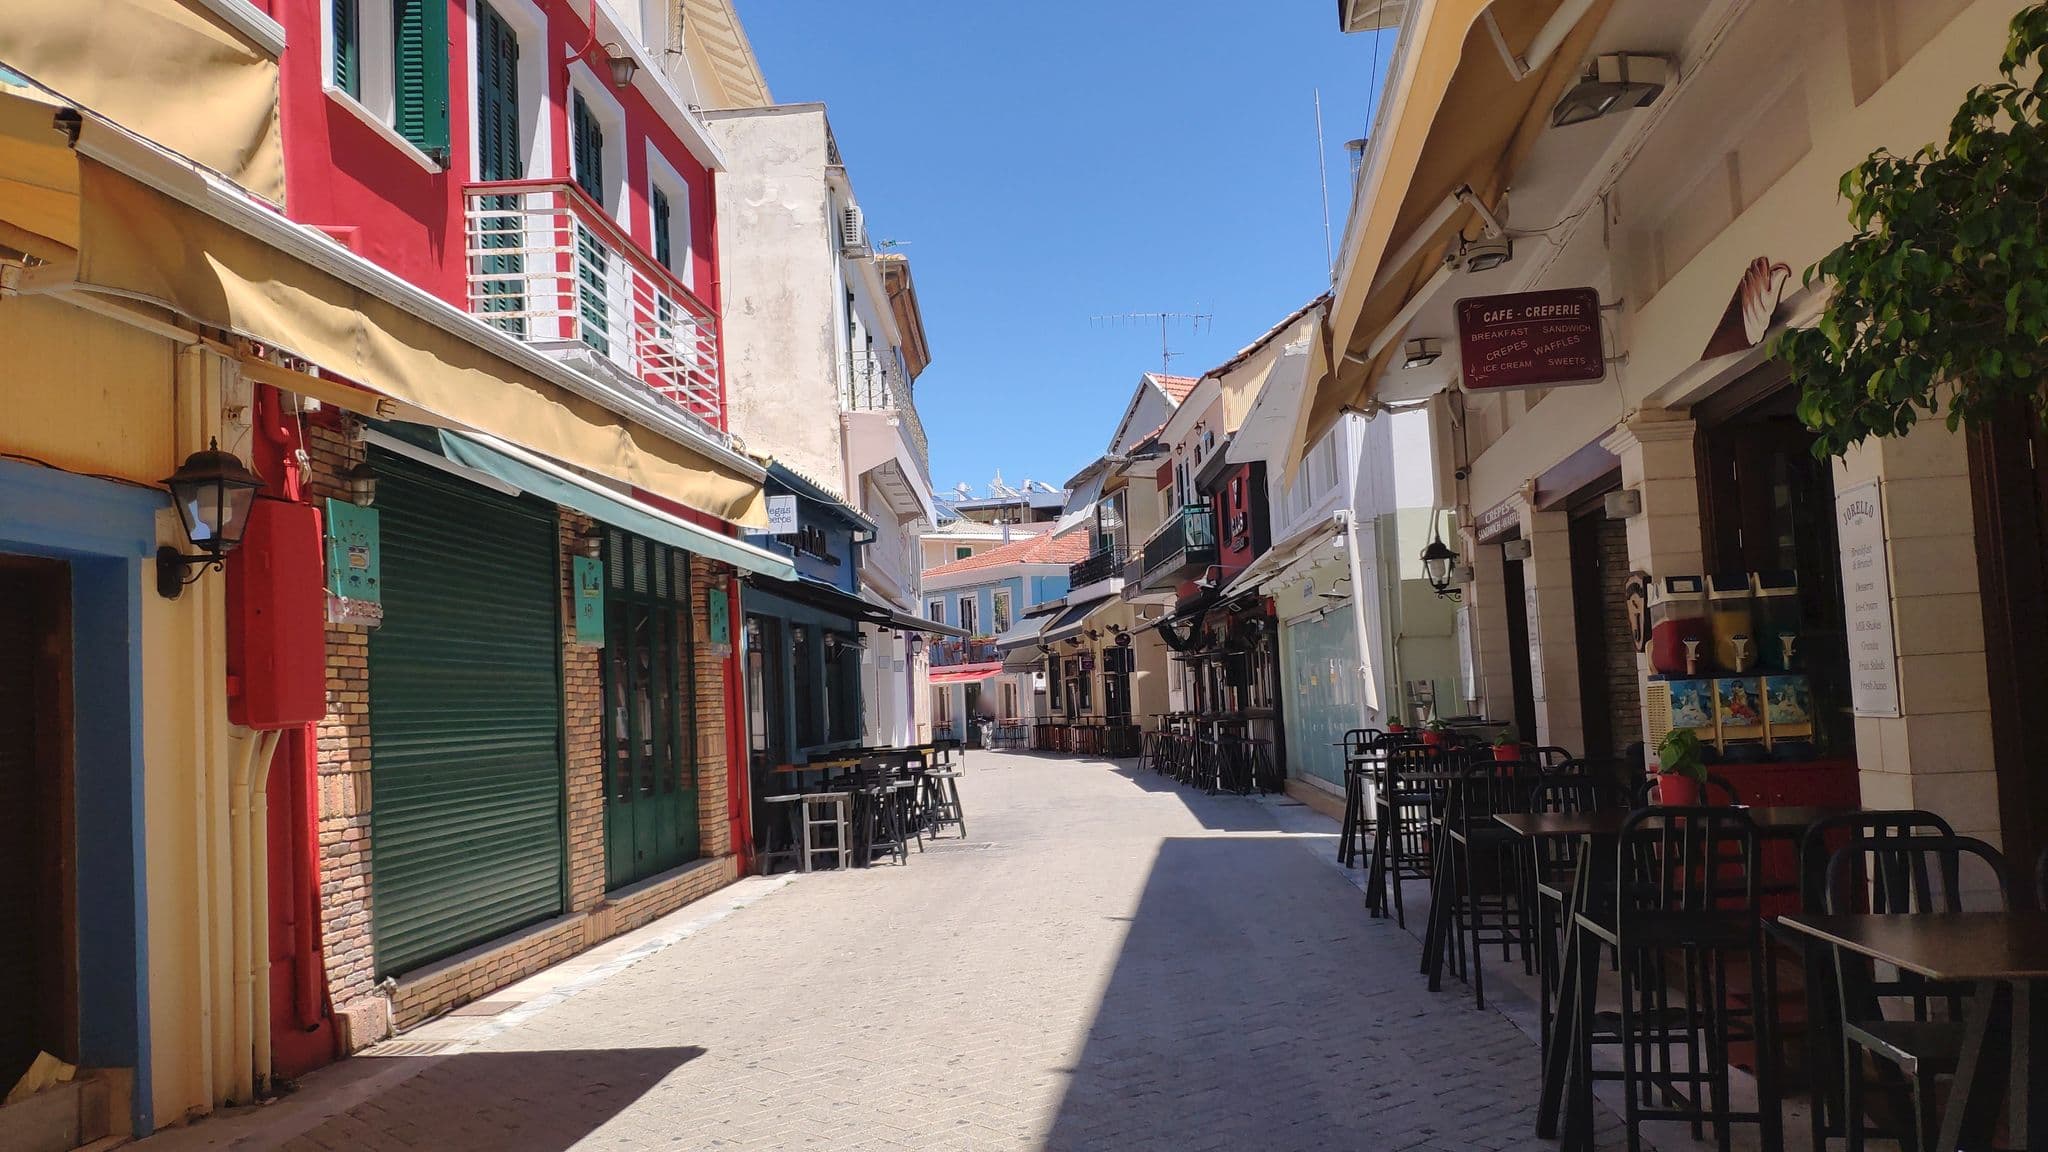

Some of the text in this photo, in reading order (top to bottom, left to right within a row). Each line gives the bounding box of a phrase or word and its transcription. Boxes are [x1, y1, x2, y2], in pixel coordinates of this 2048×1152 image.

[1483, 309, 1513, 322] CAFE
[1525, 305, 1580, 317] CREPERIE
[1471, 324, 1591, 342] BREAKFAST SANDWICH
[1486, 335, 1580, 361] CREPES WAFFLES
[1483, 356, 1586, 372] ICE CREAM SWEETS
[1485, 504, 1510, 524] CREPES
[1844, 500, 1873, 525] JORELLO
